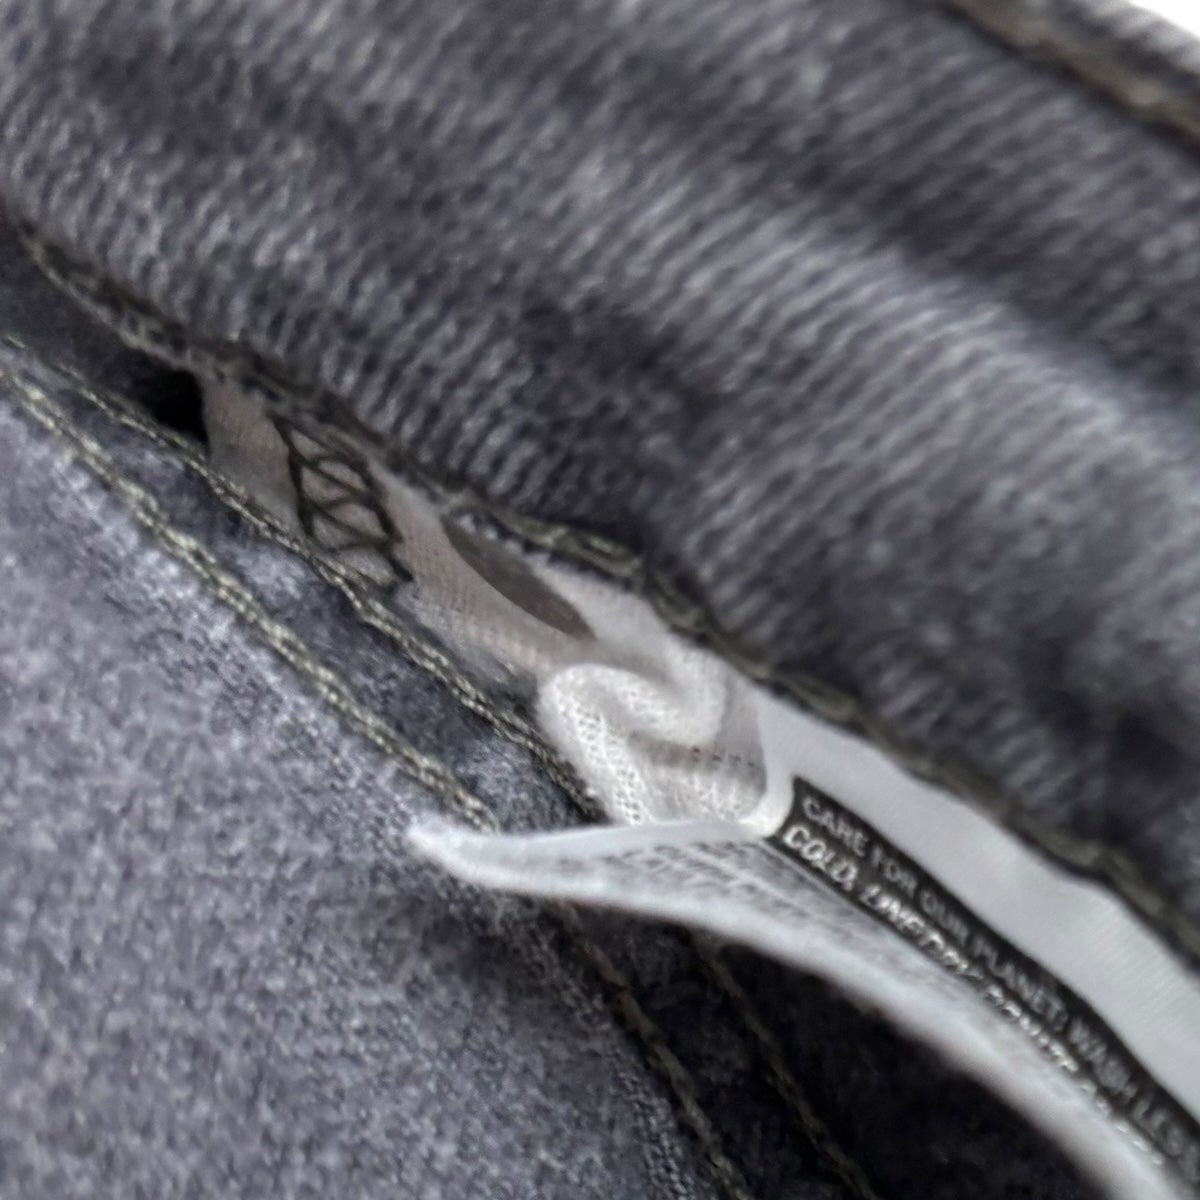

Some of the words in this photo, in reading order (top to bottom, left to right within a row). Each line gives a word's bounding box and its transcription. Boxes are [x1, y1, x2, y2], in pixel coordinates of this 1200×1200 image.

[803, 797, 868, 857] CARE
[871, 847, 917, 898] FOR
[920, 887, 969, 947] OUR
